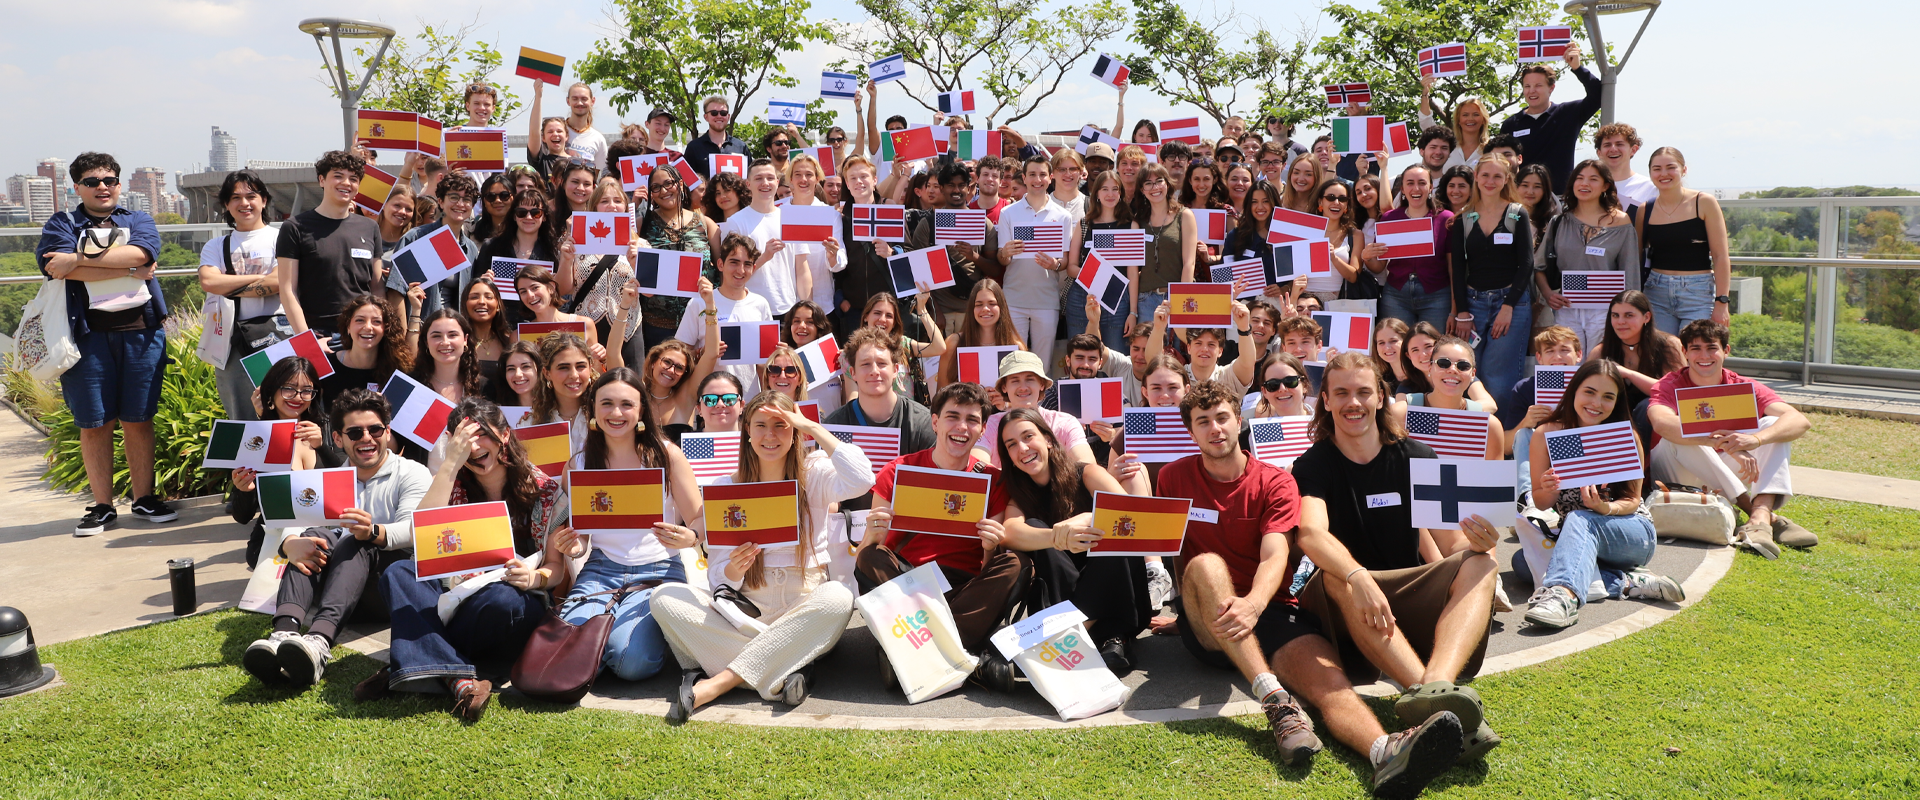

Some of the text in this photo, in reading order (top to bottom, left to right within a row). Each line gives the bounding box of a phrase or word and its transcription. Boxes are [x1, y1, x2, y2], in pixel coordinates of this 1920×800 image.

[1094, 146, 1101, 154] P
[905, 627, 934, 650] lla
[1056, 650, 1085, 671] lla
